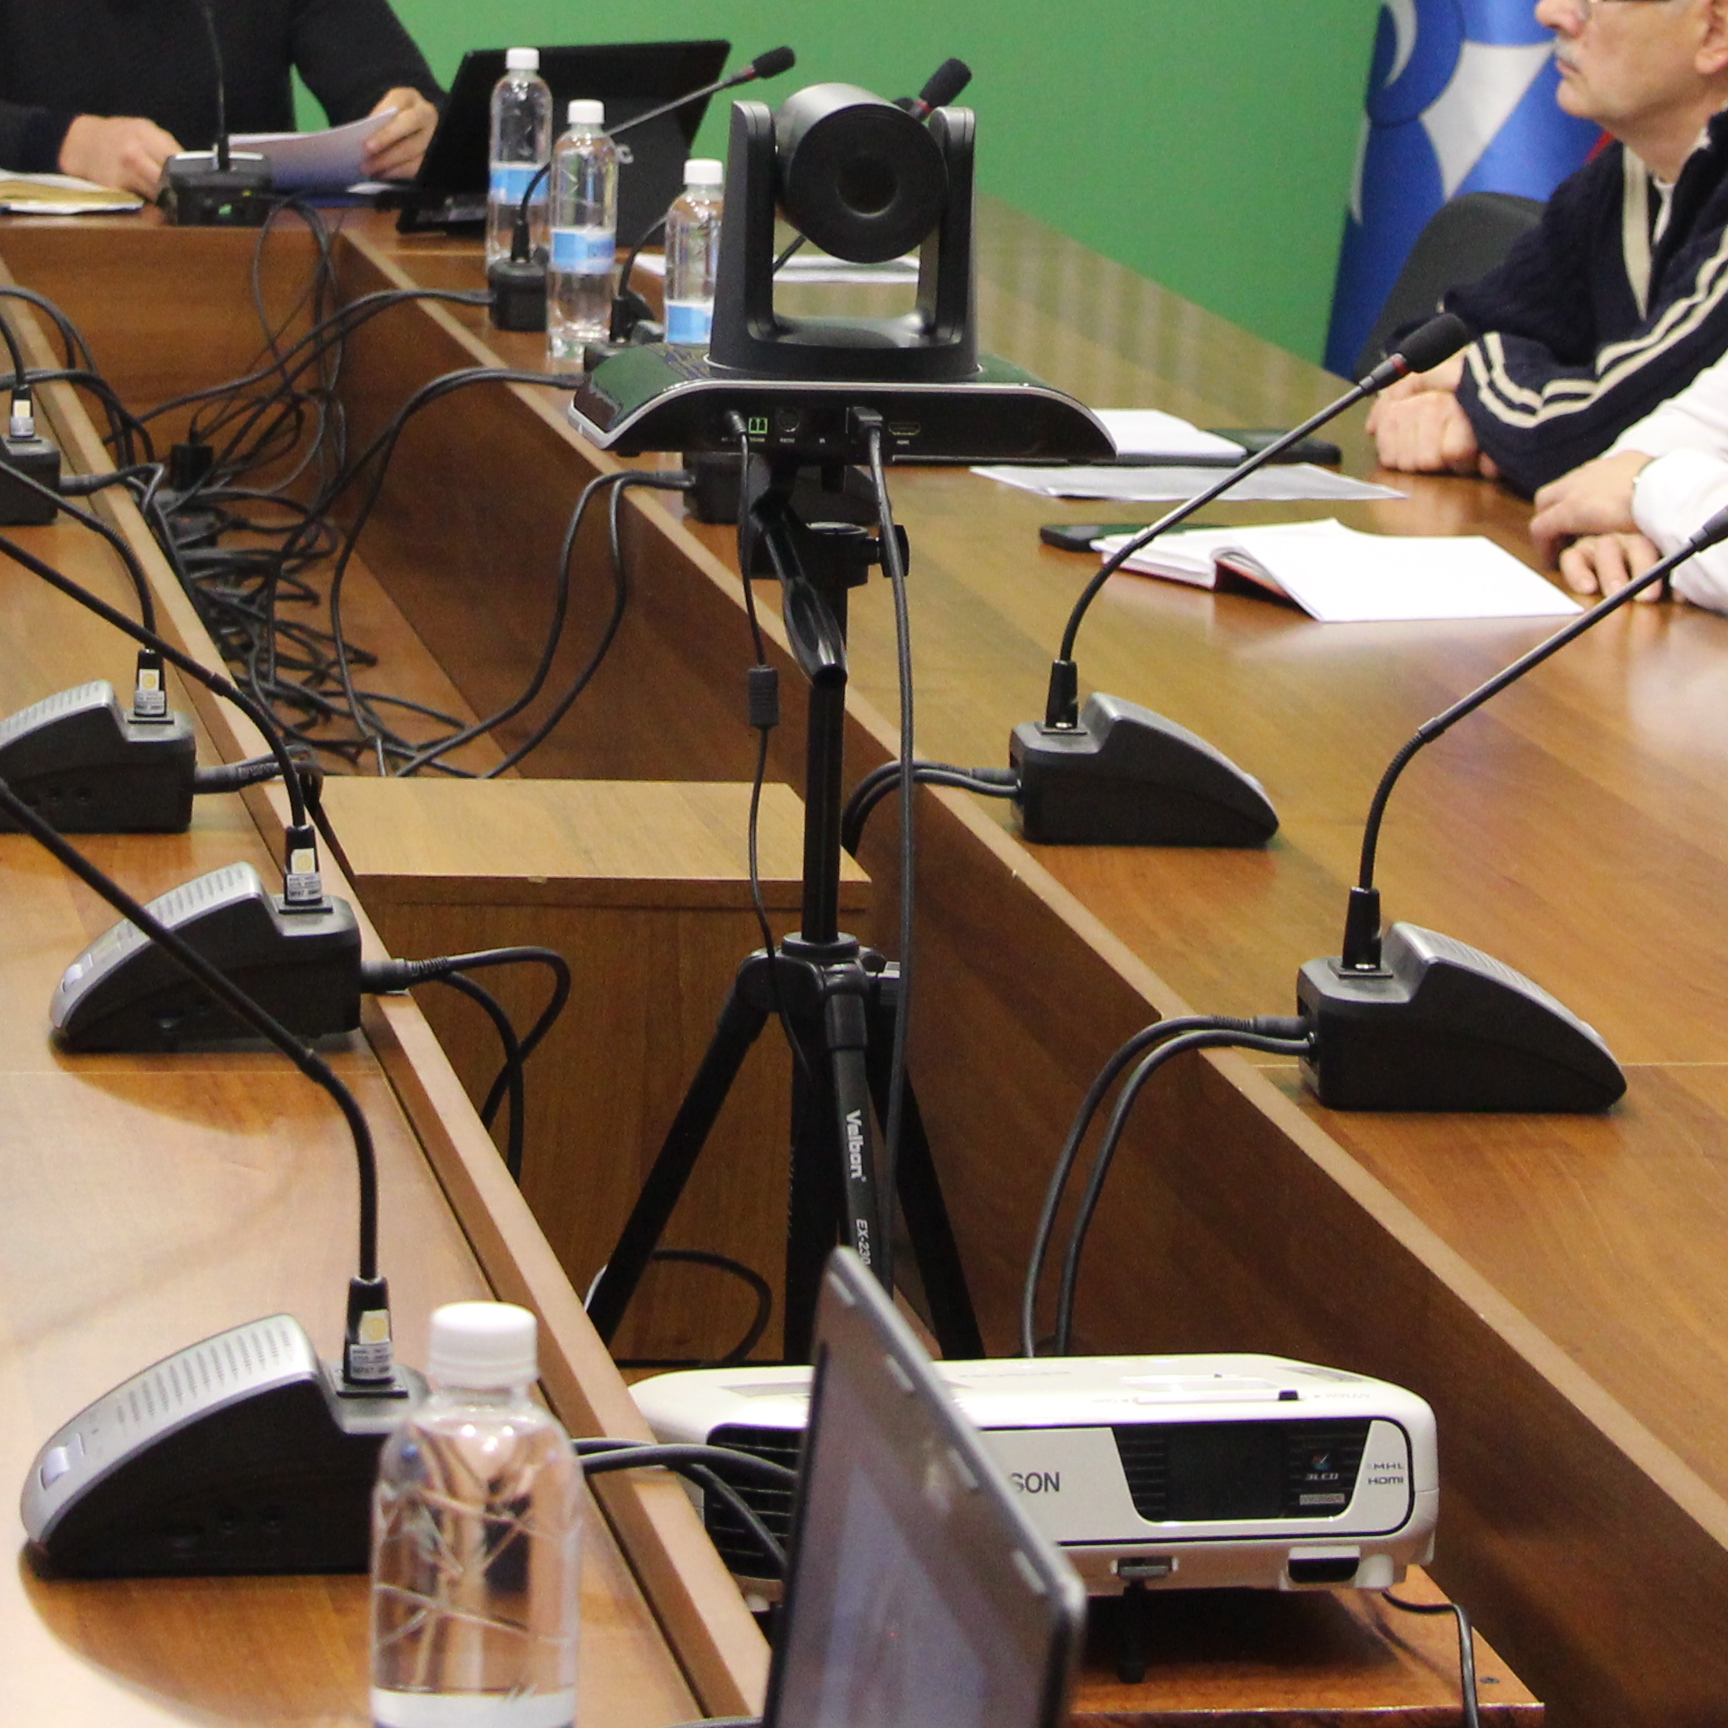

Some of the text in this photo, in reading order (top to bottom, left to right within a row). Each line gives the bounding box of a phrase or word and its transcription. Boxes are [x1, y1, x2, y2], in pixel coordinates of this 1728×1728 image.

[846, 1109, 864, 1179] Velbon
[1010, 1471, 1061, 1494] SON
[1368, 1475, 1404, 1485] HDMI
